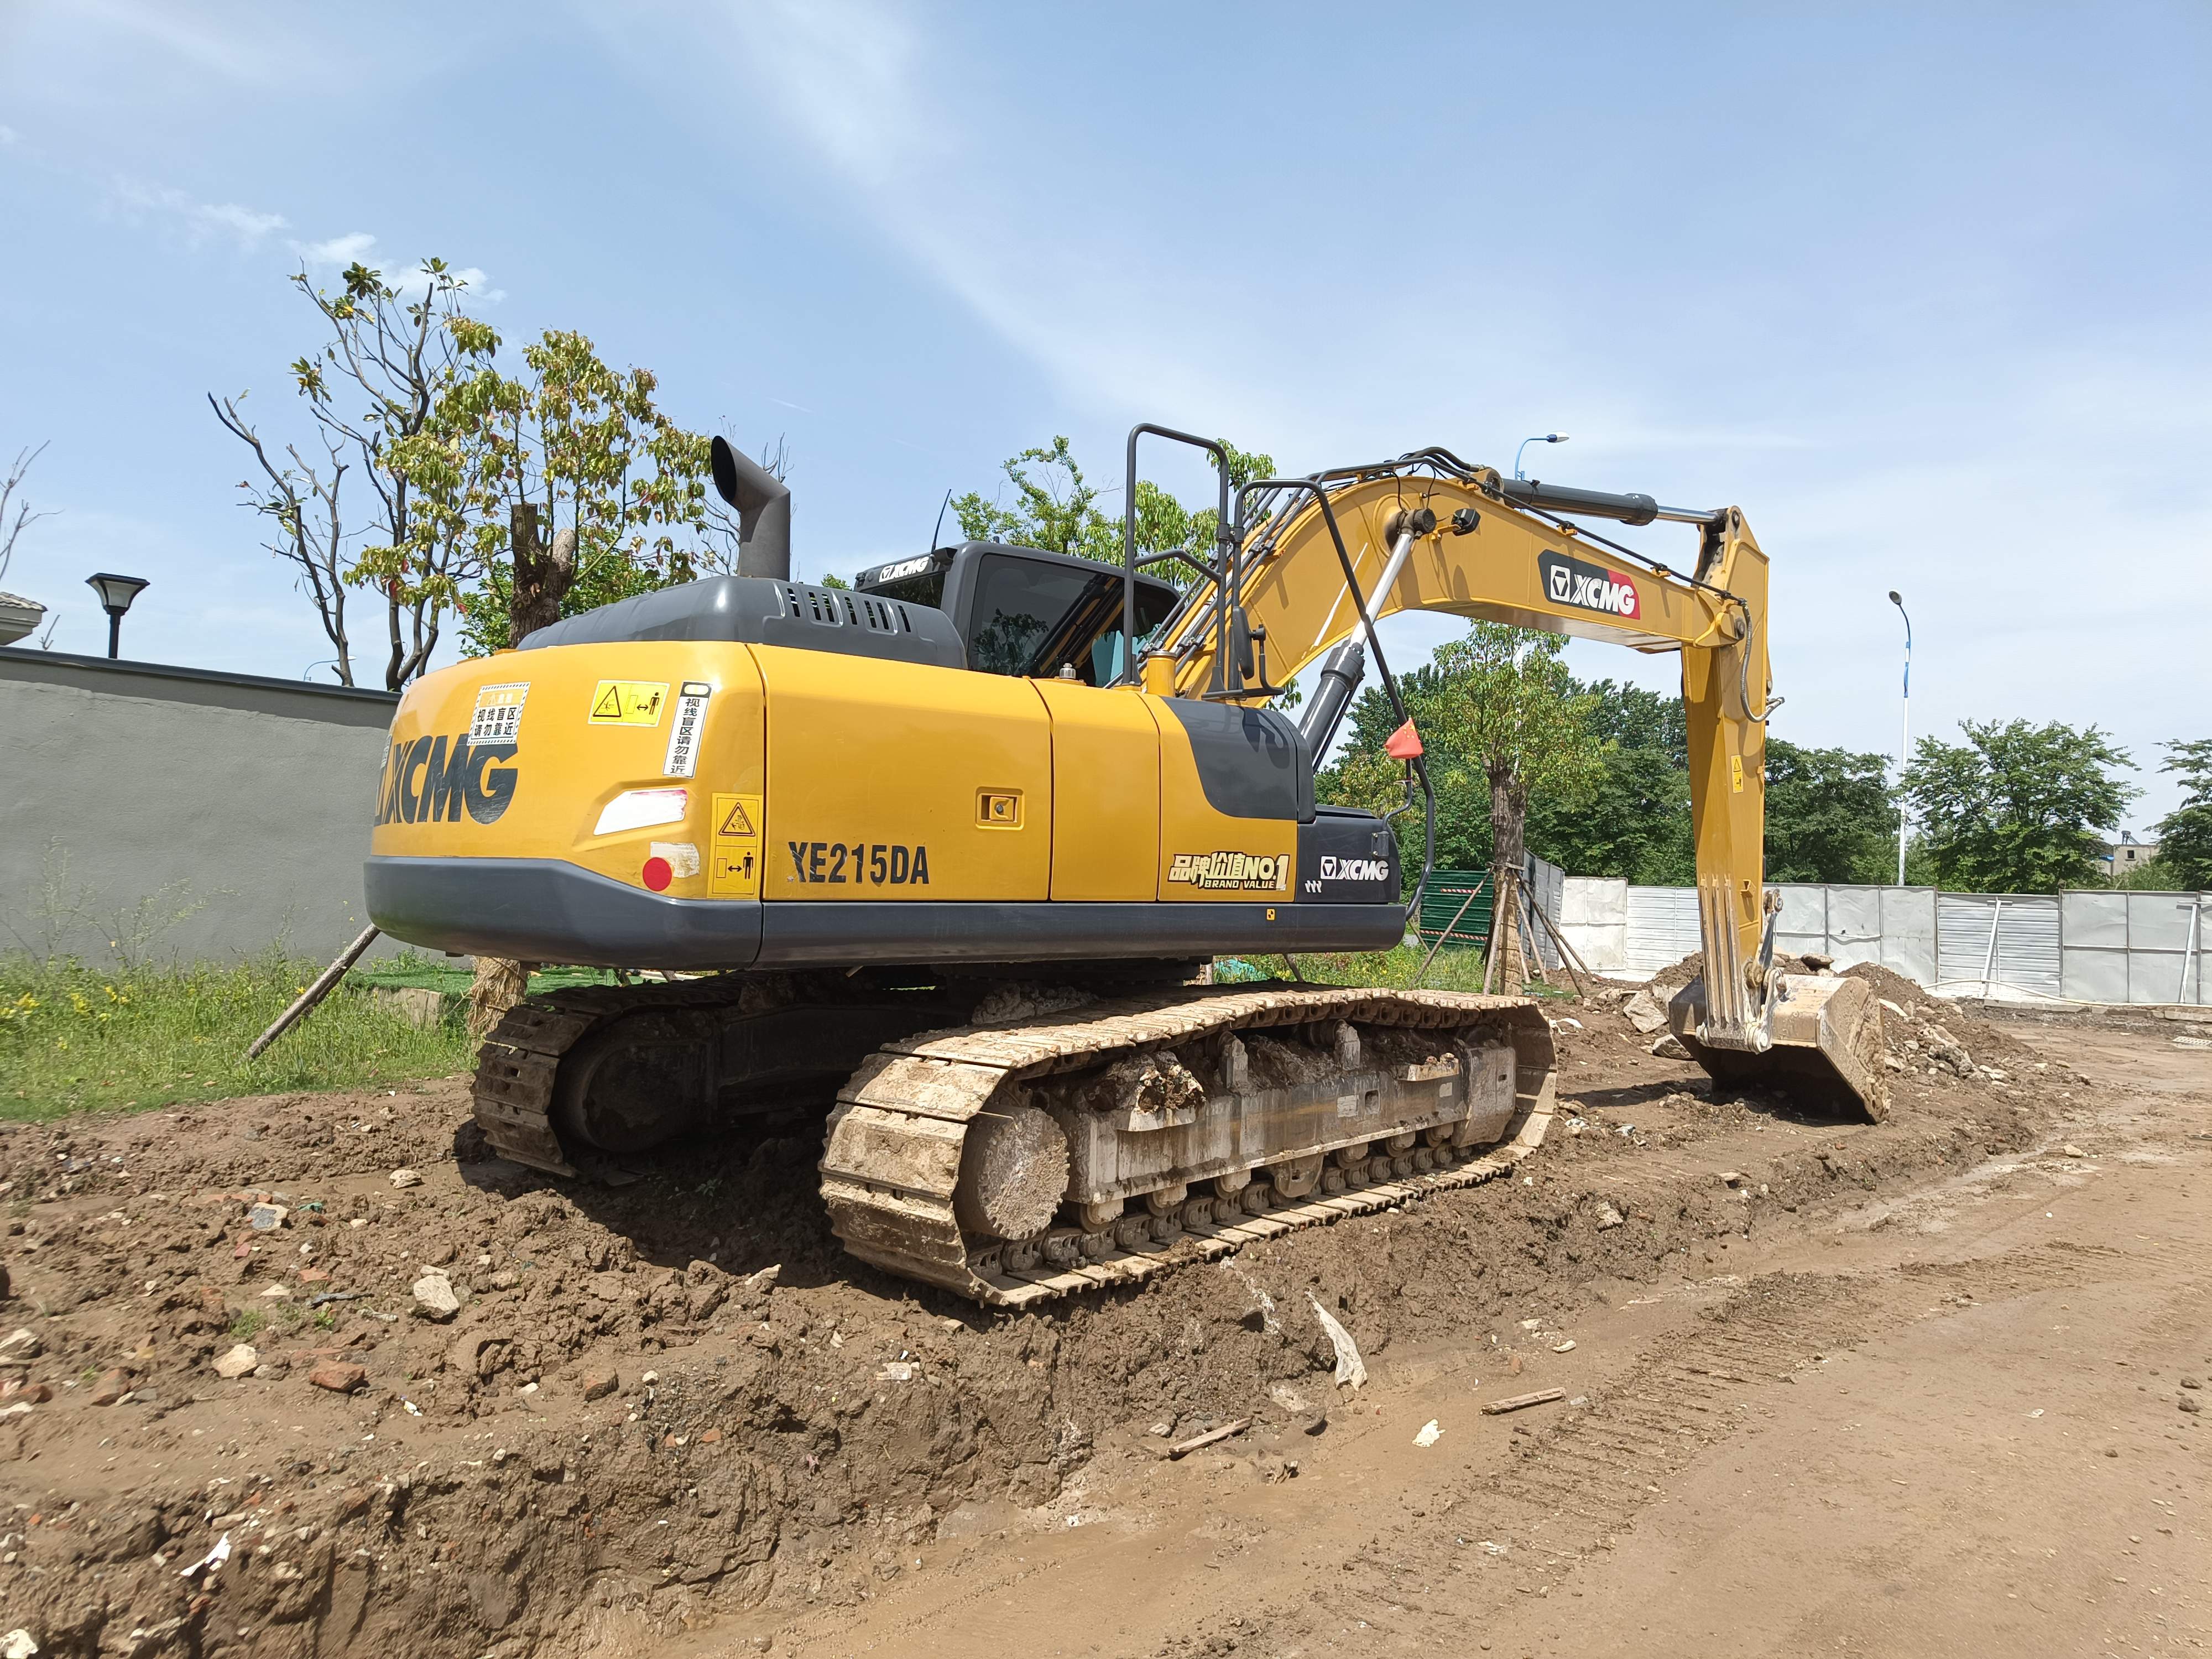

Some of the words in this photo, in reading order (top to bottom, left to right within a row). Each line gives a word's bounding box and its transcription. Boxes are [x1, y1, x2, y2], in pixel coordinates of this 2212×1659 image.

[893, 556, 929, 578] XCMG
[1570, 573, 1635, 615] XCMG
[477, 707, 517, 722] 视线盲区
[474, 722, 514, 737] 请勿靠近
[670, 698, 700, 775] 视线盲区请勿靠近
[382, 733, 518, 825] XCMG
[1335, 858, 1389, 881] XCMG
[1204, 880, 1239, 888] BRAND
[1244, 880, 1274, 889] VALUE
